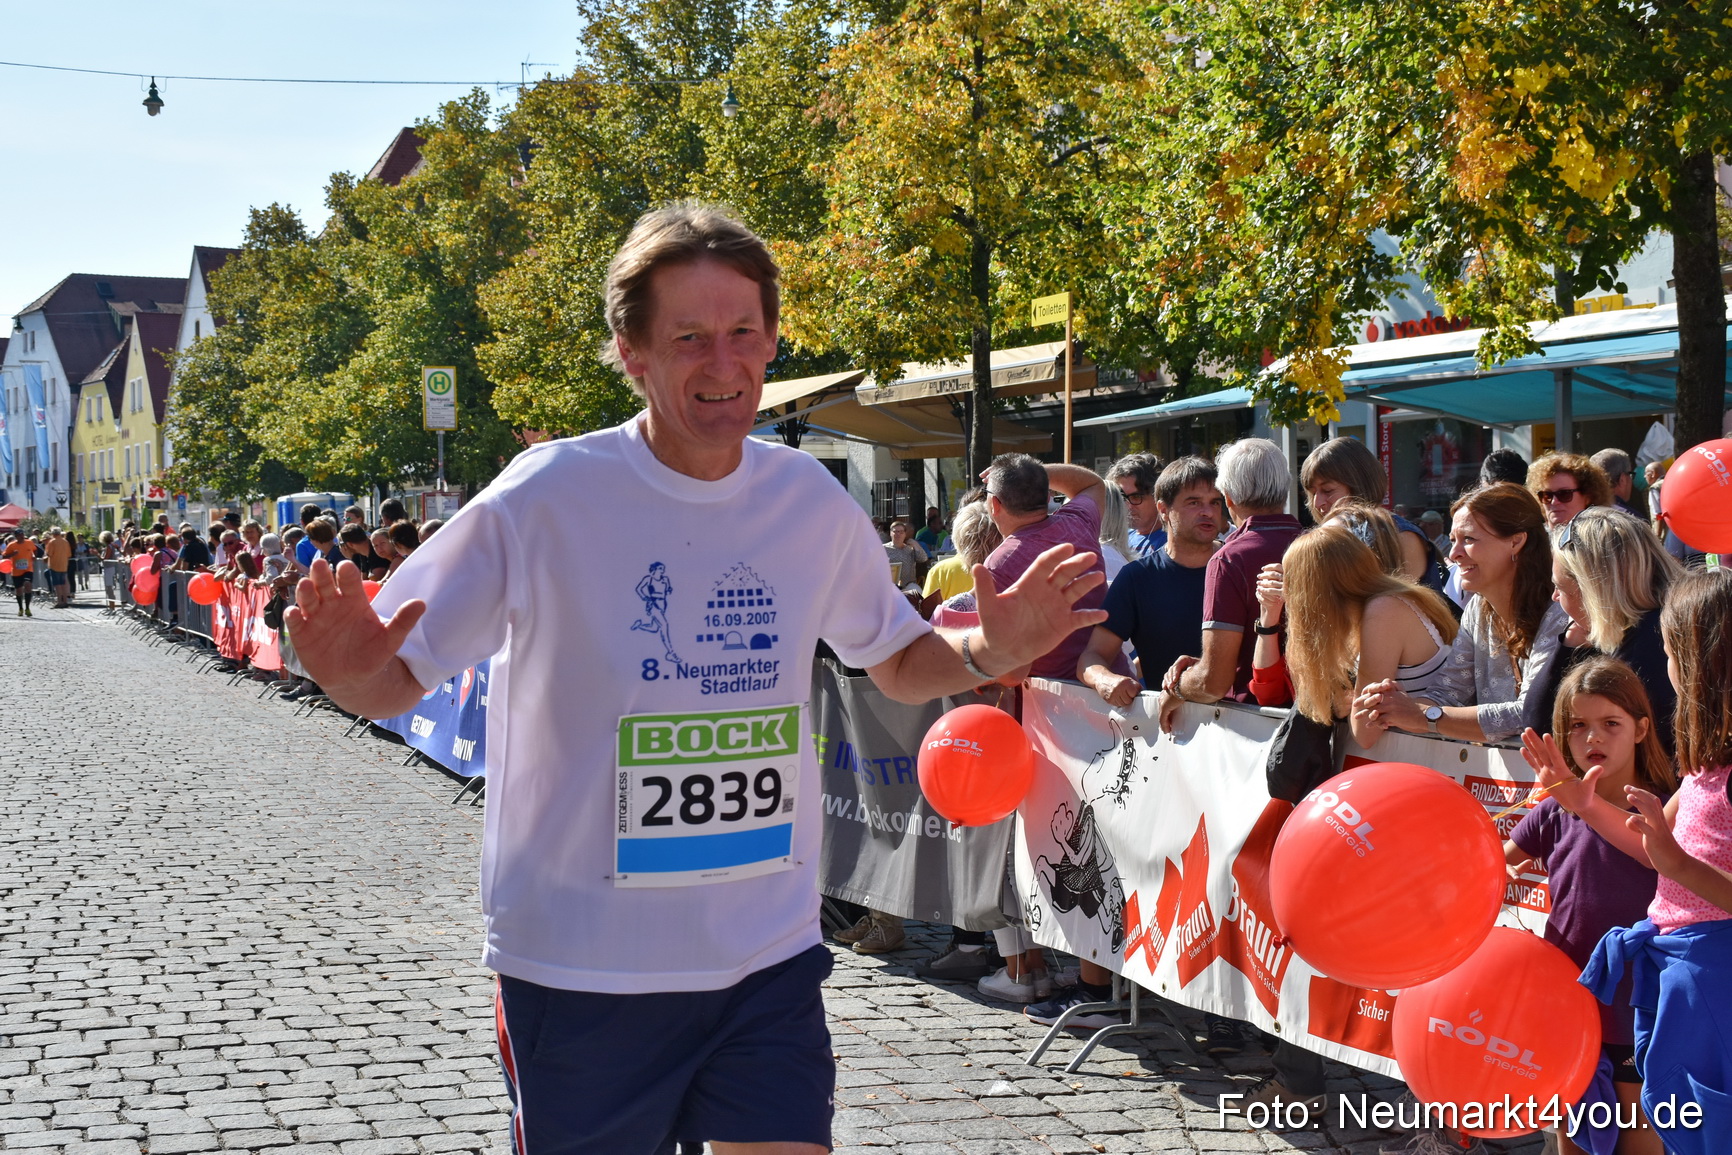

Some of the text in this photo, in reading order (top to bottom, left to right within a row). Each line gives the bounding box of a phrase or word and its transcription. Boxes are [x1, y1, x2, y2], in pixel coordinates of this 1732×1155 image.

[1038, 302, 1067, 318] Toiletten
[704, 611, 777, 627] 16.09.2007
[641, 658, 780, 682] 8. Neumarkter
[700, 673, 780, 696] Stadtlauf
[632, 712, 789, 760] BOCK
[641, 767, 782, 827] 2839
[1502, 883, 1546, 909] ANDER
[1357, 998, 1390, 1022] Sicher
[1483, 1053, 1538, 1081] energie
